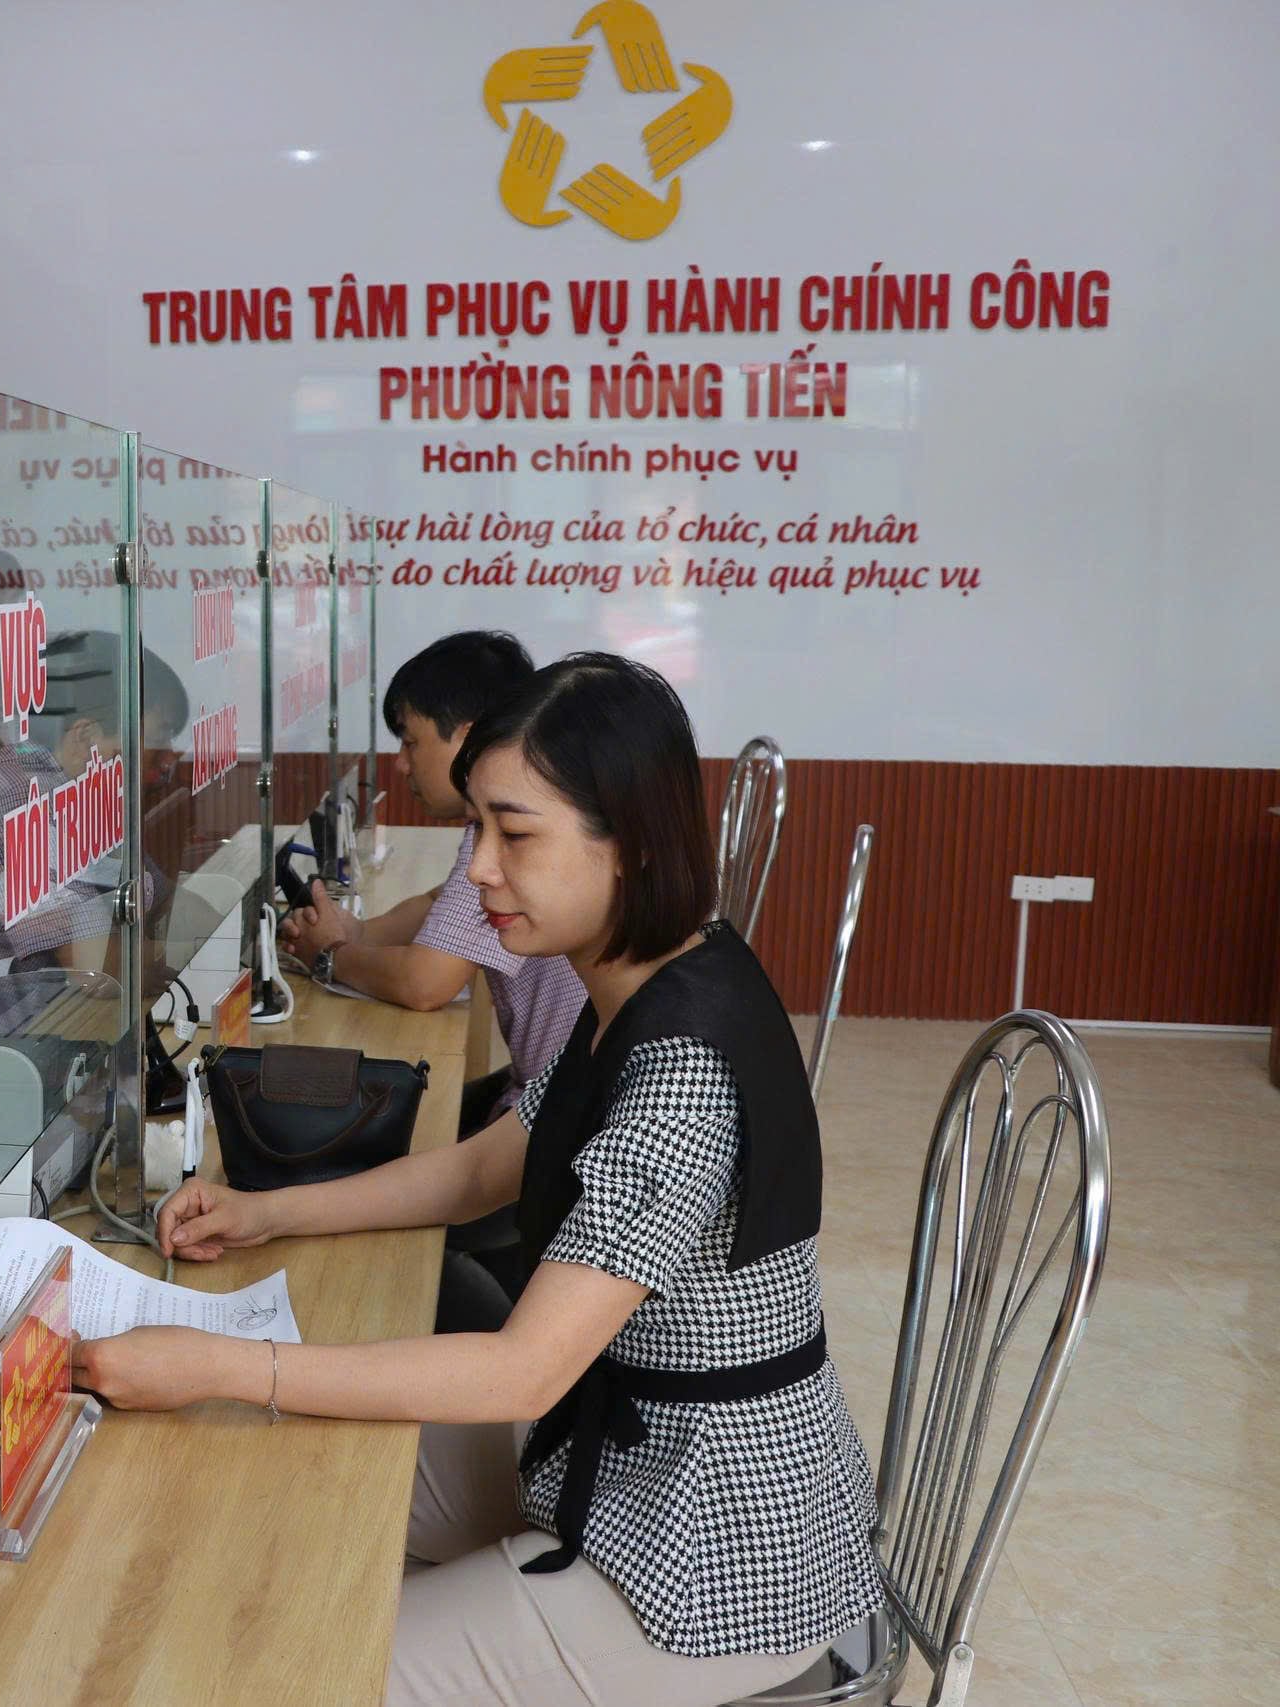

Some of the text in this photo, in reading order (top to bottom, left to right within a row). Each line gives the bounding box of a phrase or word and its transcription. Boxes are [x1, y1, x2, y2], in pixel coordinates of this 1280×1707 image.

[143, 259, 1111, 349] TRUNG TÂM PHỤC VỤ HÀNH CHÍNH CÔNG
[379, 343, 848, 421] PHƯỜNG NÔNG TIẾN
[422, 443, 799, 481] Hành chính phục vụ
[375, 506, 919, 549] sự hài lòng của tổ chức, cá nhân
[391, 556, 981, 597] đo chất lượng và hiệu quả phục vụ
[5, 779, 51, 928] MÔI
[53, 746, 124, 890] TRƯỜNG
